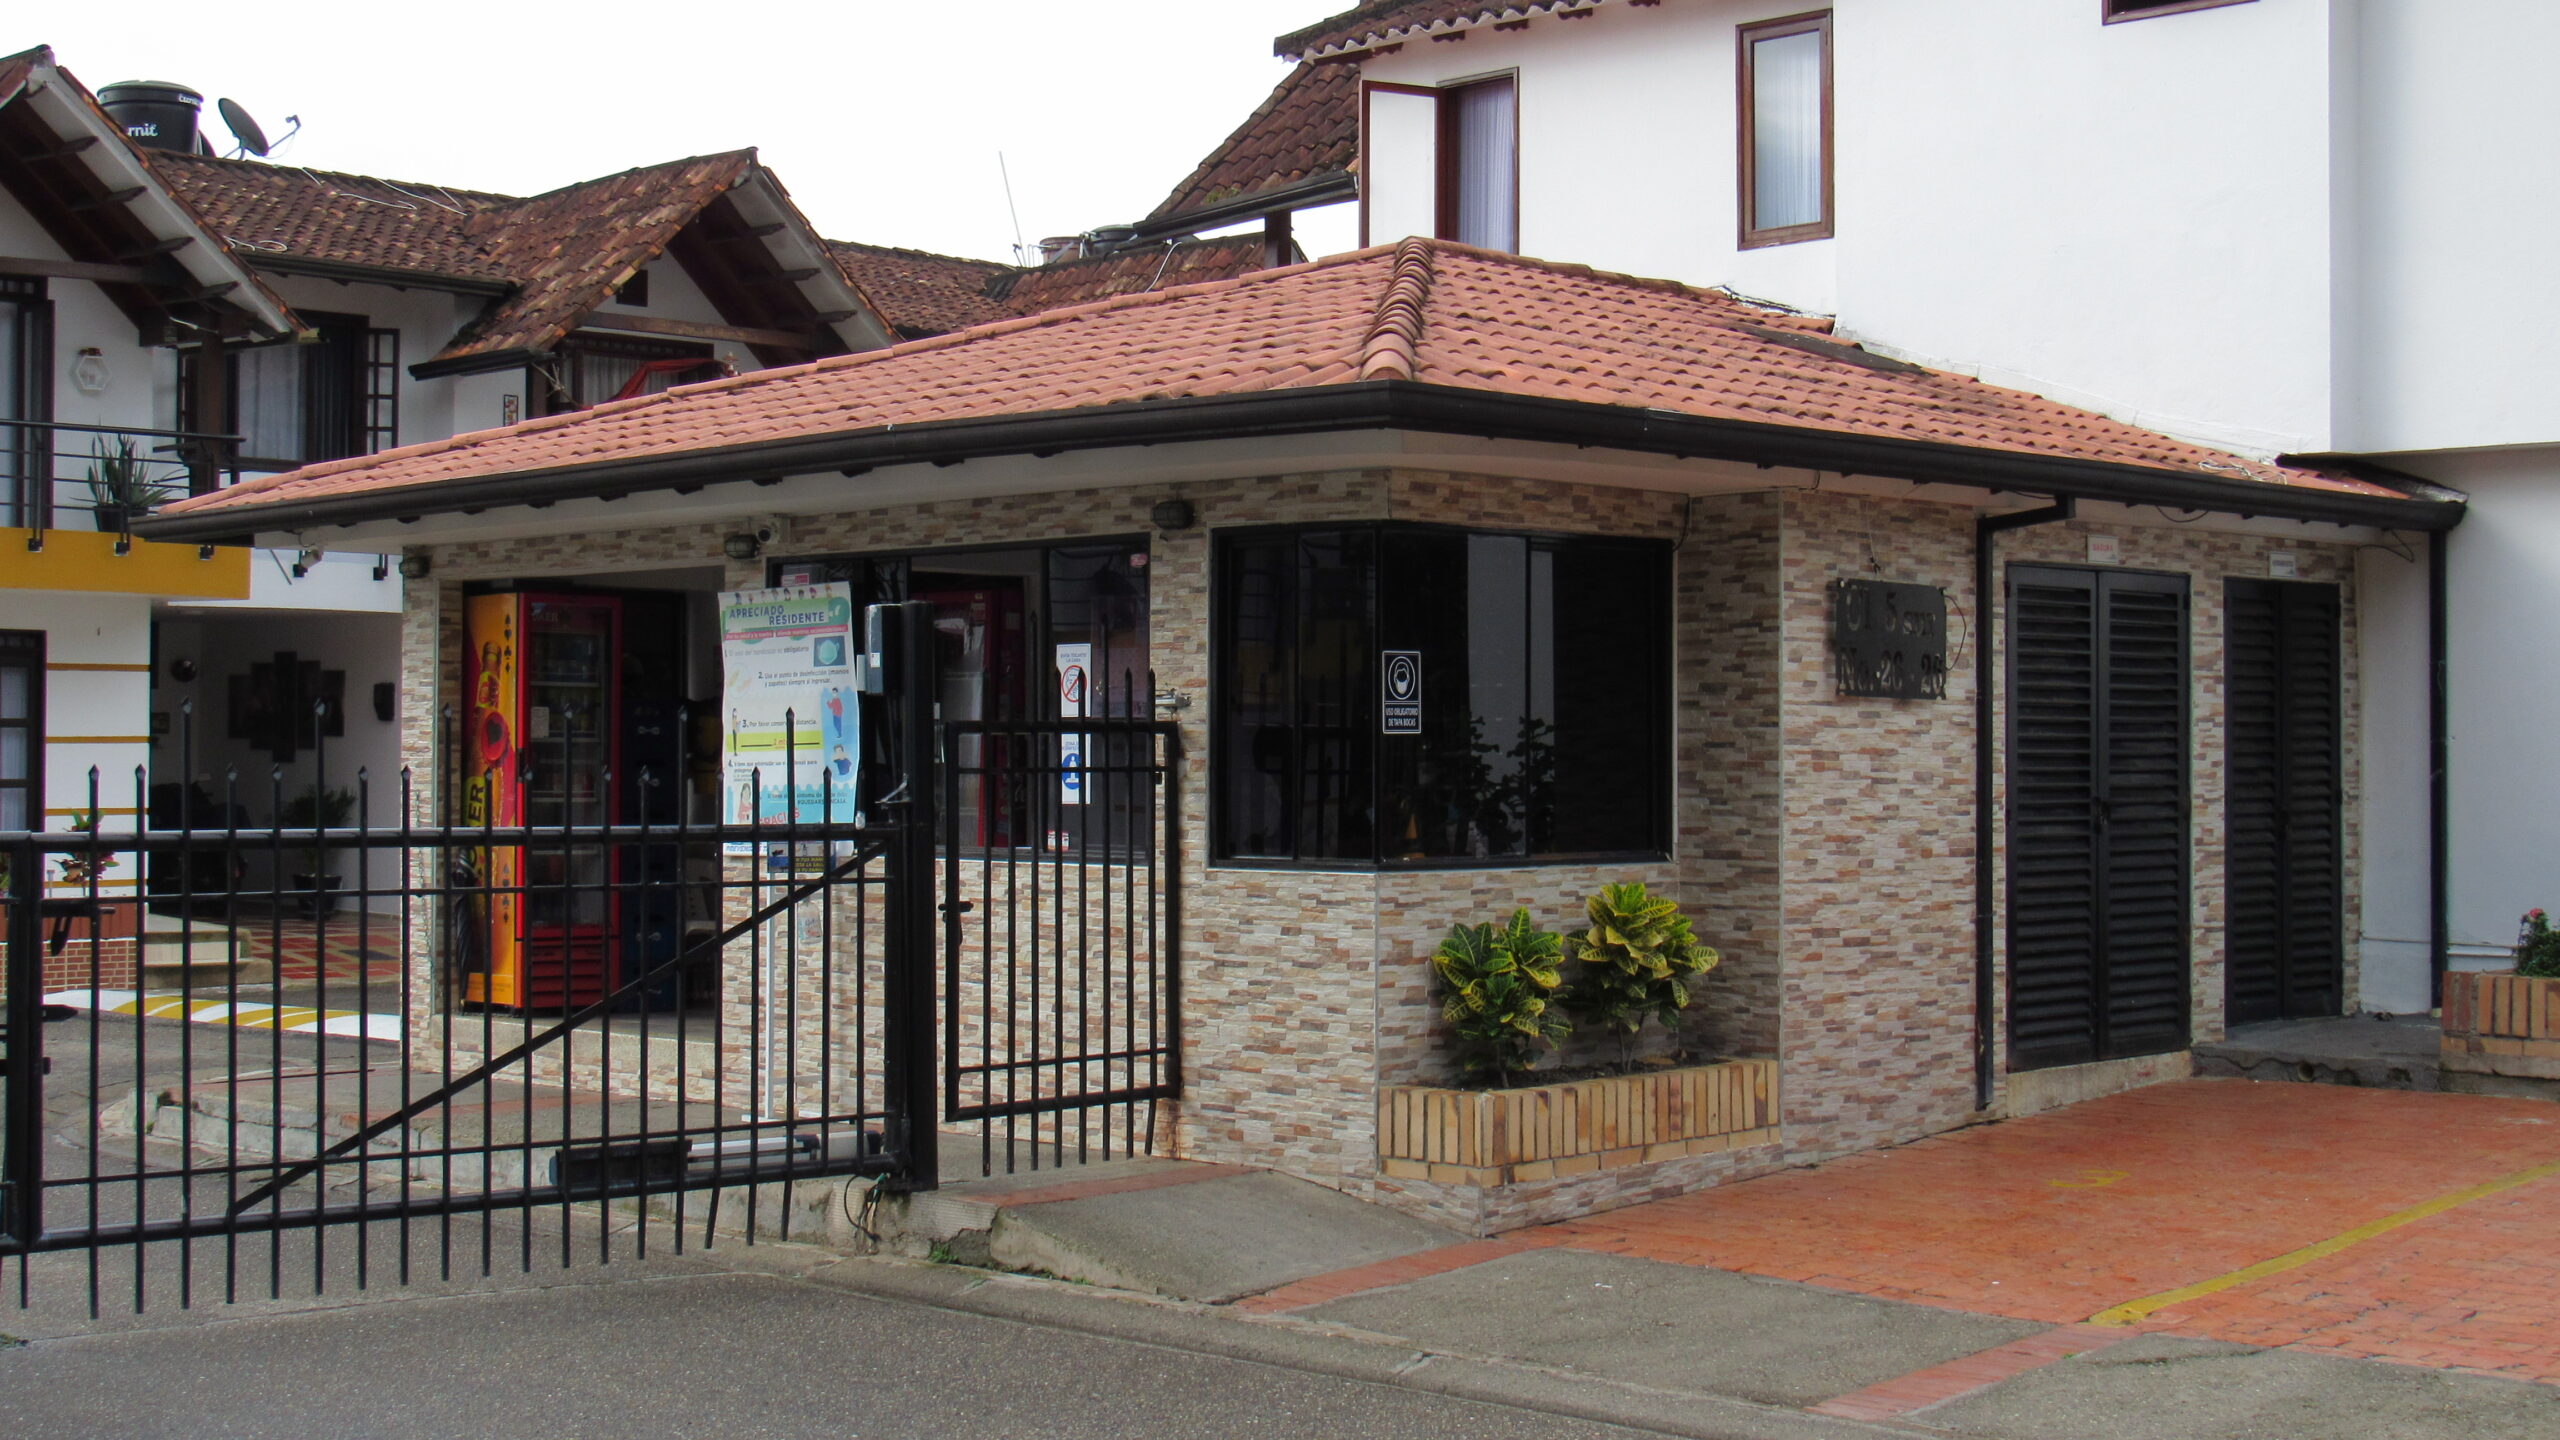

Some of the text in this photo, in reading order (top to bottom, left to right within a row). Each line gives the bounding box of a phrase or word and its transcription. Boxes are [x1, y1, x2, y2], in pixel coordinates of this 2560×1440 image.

[127, 122, 158, 137] rnit
[729, 605, 785, 619] APRECIADO
[769, 611, 825, 626] RESIDENTE
[1394, 707, 1418, 715] OBLIGATORIO
[1404, 718, 1416, 726] BOCAS
